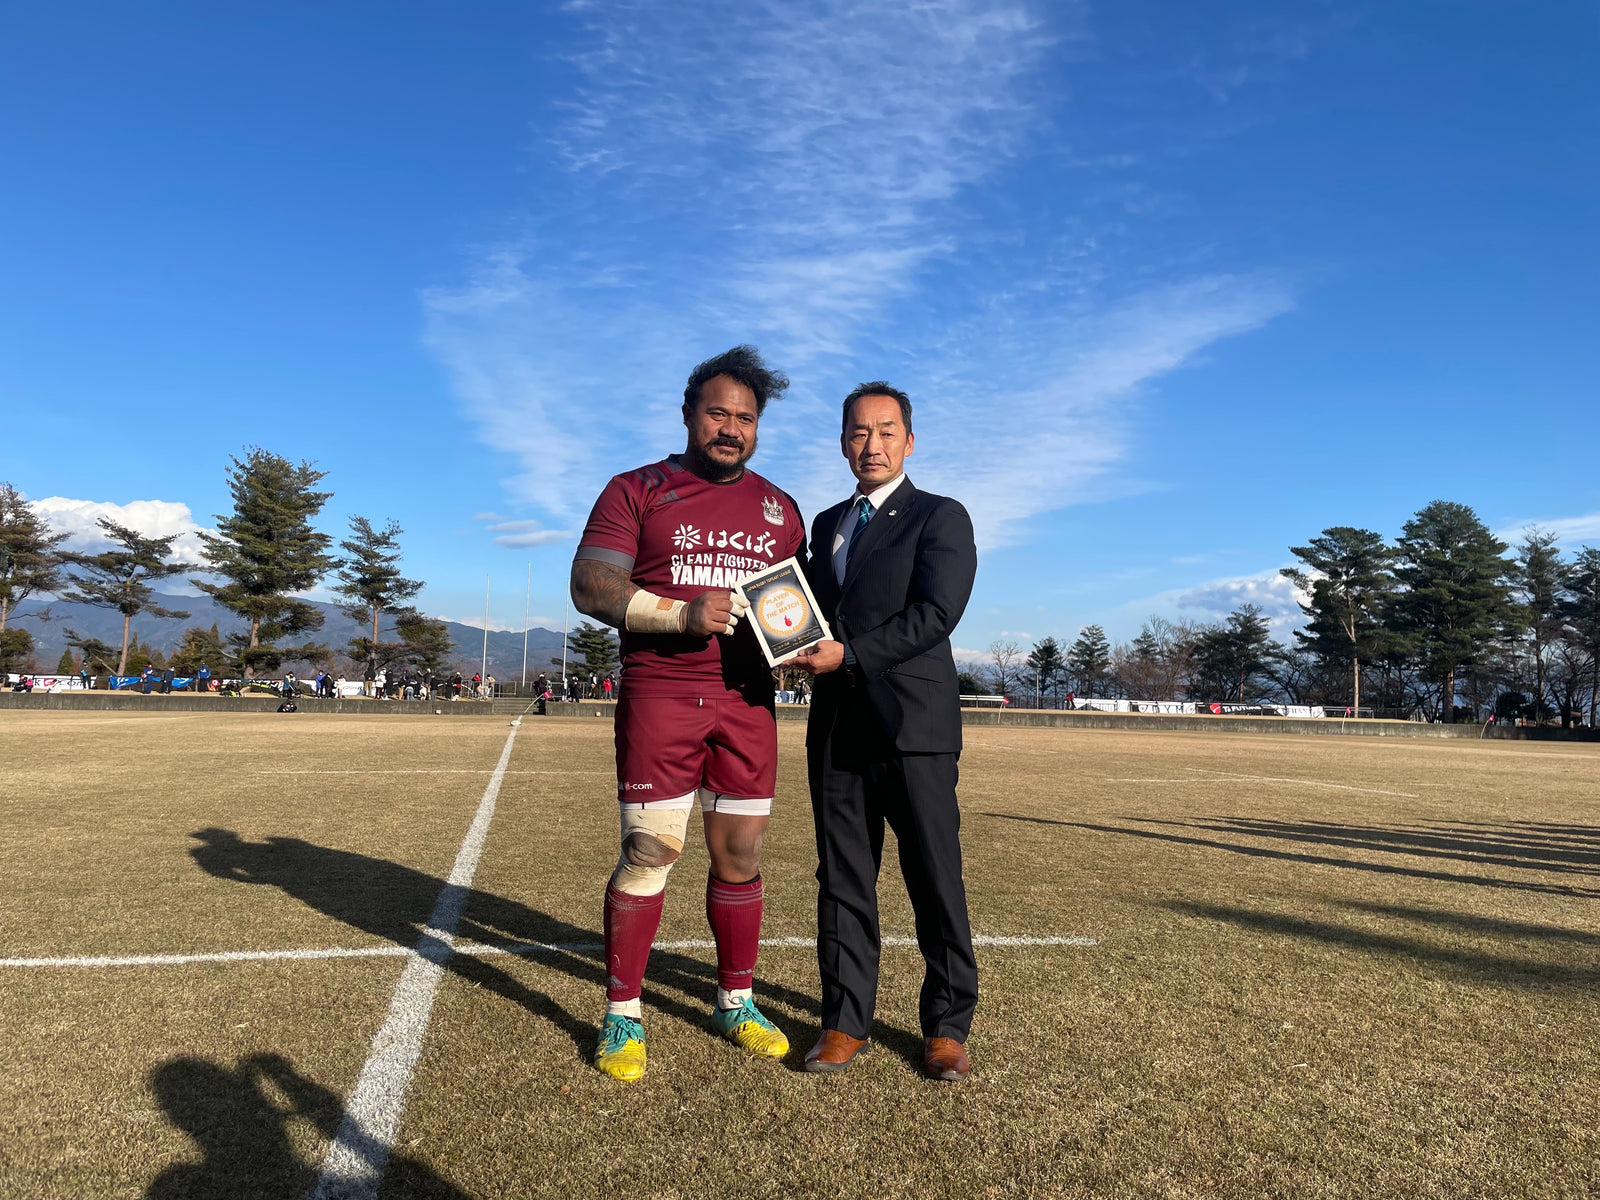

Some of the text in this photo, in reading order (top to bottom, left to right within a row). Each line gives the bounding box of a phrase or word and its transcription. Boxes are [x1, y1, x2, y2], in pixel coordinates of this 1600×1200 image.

[707, 529, 777, 559] はくばく
[671, 553, 713, 567] CLEAN
[766, 592, 790, 606] PLAYER
[775, 601, 784, 609] OF
[766, 600, 800, 619] THE MATCH
